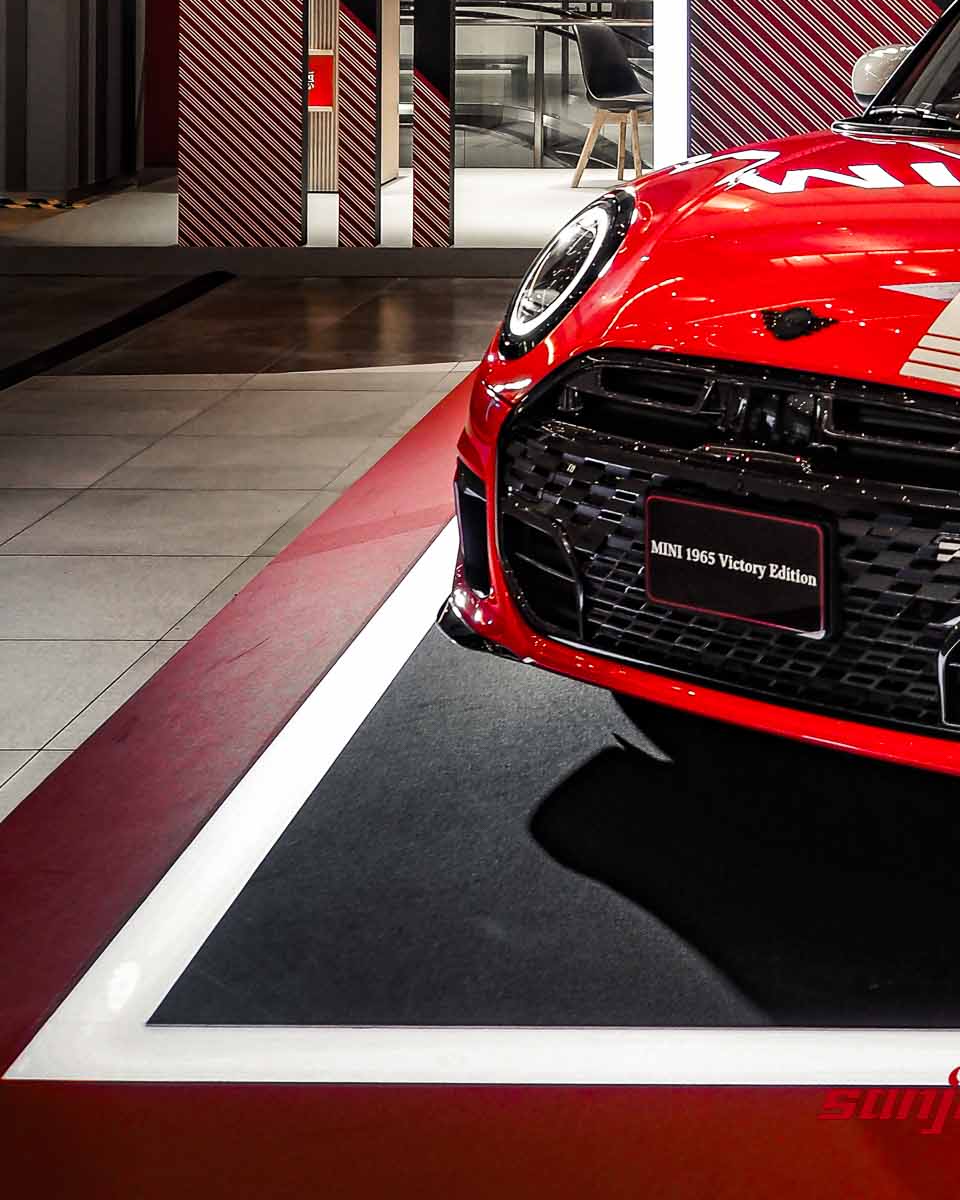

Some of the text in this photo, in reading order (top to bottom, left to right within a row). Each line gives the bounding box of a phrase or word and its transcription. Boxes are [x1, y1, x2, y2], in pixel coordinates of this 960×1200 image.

[651, 539, 818, 587] MINI 1965 Victory Edition
